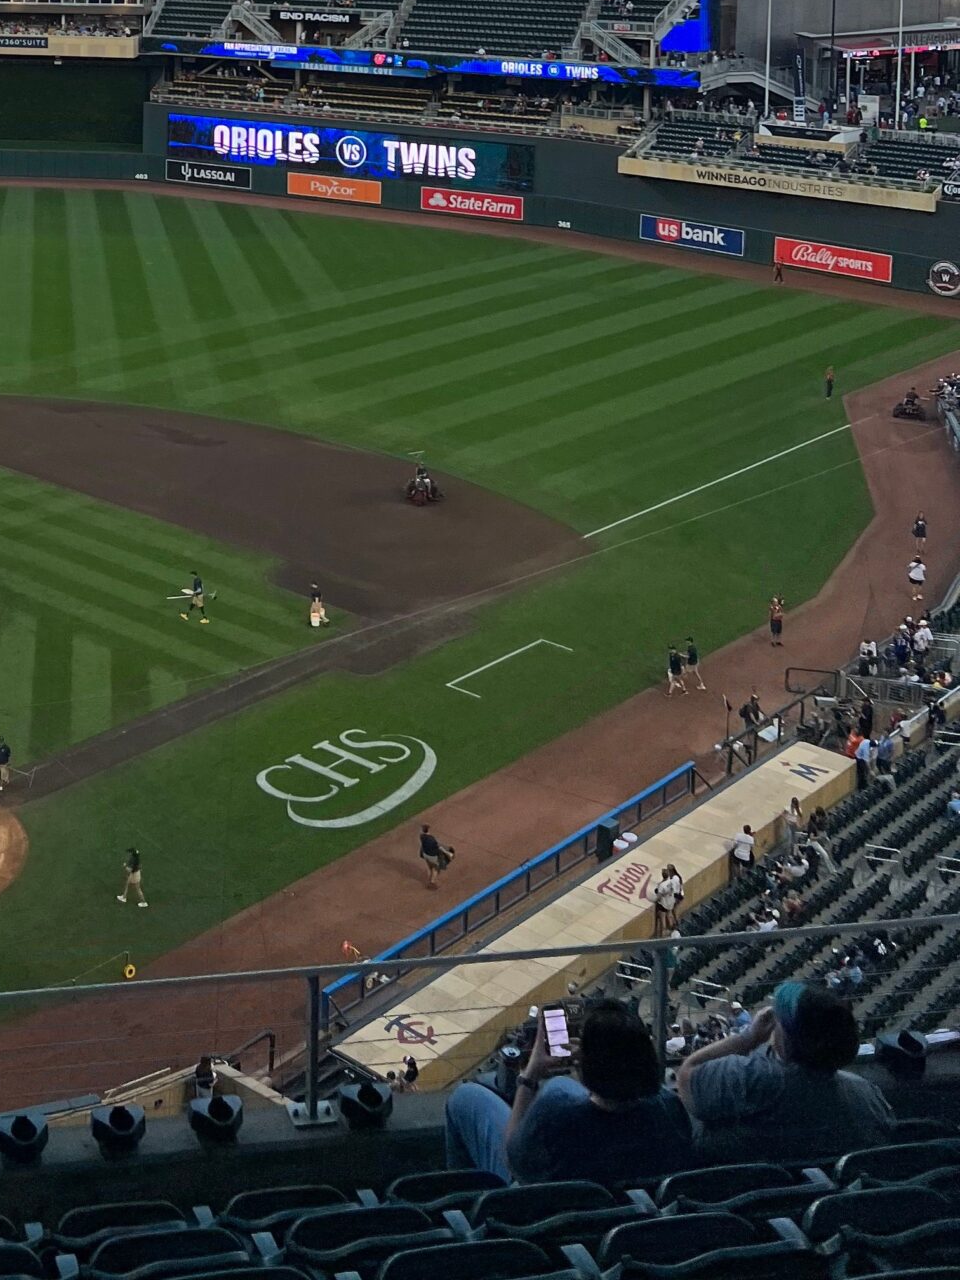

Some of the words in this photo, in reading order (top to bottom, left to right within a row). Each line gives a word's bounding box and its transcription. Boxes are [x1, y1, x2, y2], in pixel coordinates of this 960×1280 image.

[279, 12, 303, 20] END
[305, 12, 350, 23] RACISM
[22, 39, 46, 47] SUITE
[300, 62, 338, 72] TREASURE
[341, 65, 369, 73] ISLAND
[501, 62, 542, 75] ORIOLES
[565, 66, 599, 79] TWINS
[213, 124, 320, 164] ORIOLES
[343, 143, 361, 161] VS
[384, 139, 476, 180] TWINS
[193, 168, 235, 182] LASSO.AI
[696, 169, 767, 187] WINNEBAGO
[767, 179, 843, 197] INDUSTRIES
[310, 181, 356, 197] Paycor
[658, 222, 679, 237] us
[681, 222, 725, 246] bank
[792, 243, 839, 270] Bally
[838, 258, 873, 272] SPORTS
[256, 728, 411, 803] CHS
[597, 862, 650, 901] Twins
